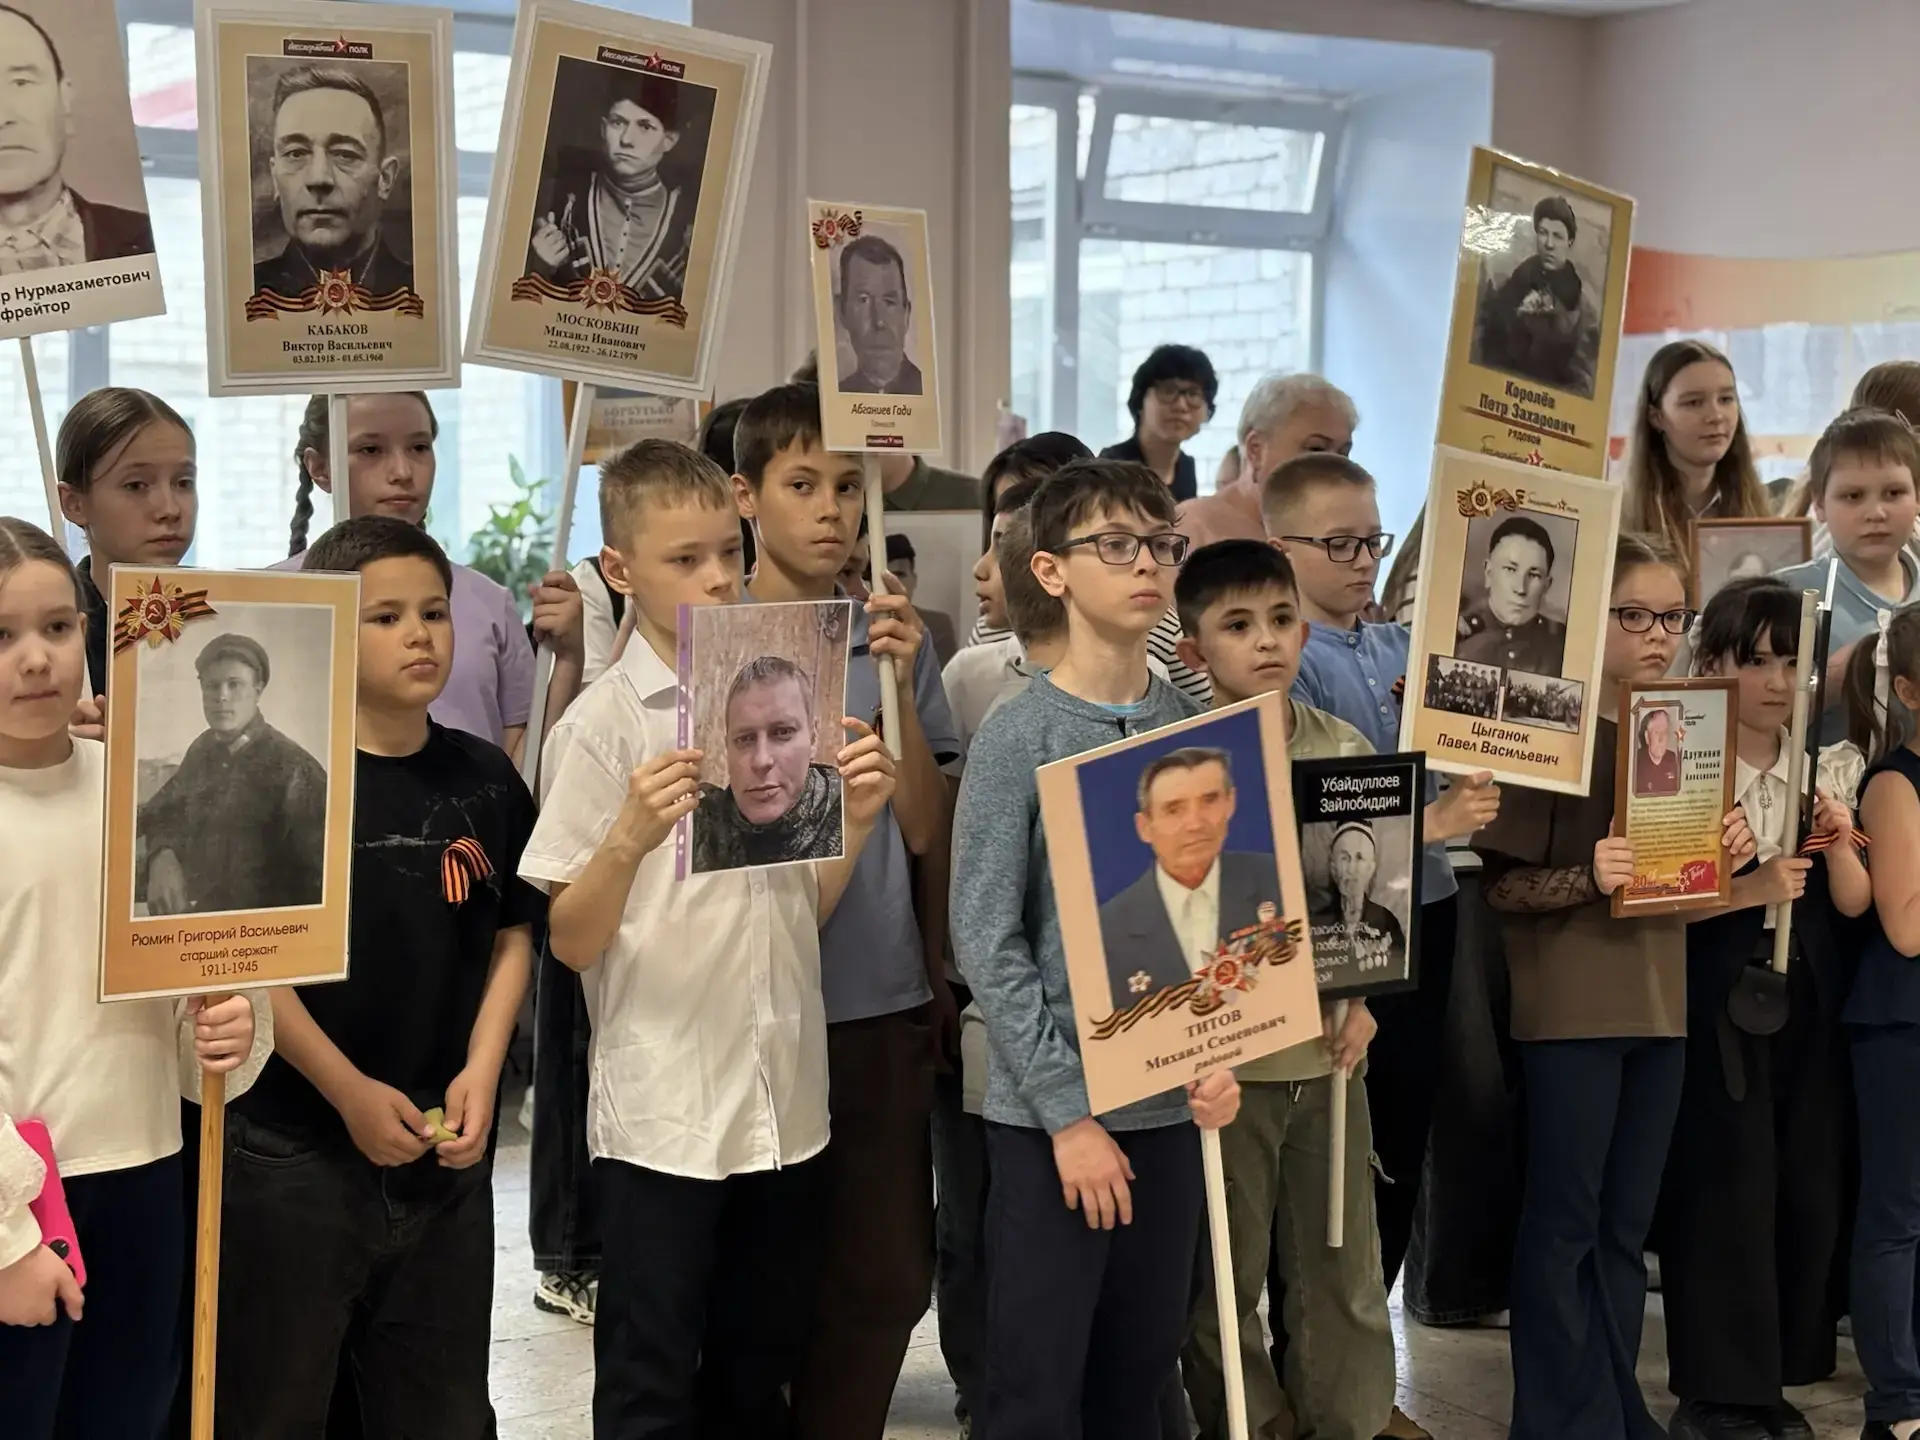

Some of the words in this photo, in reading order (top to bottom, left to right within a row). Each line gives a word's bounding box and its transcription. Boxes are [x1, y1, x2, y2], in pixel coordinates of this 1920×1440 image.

[0, 292, 11, 304] р
[15, 270, 151, 301] Нурмахаметович
[0, 300, 71, 323] фрейтор
[307, 324, 368, 336] КАБАКОВ
[556, 312, 640, 336] МОСКОВКИН
[282, 341, 324, 353] Виктор
[328, 340, 392, 351] Васильевич
[544, 325, 589, 342] Михаил
[592, 333, 646, 351] Иванович
[292, 354, 335, 364] 03.02.1918
[596, 348, 639, 361] 26.12.1979
[1505, 380, 1556, 409] Королёв
[851, 403, 891, 415] Абганиев
[892, 404, 912, 416] Гади
[1479, 393, 1508, 416] Петр
[1511, 403, 1576, 436] Захарович
[1471, 721, 1530, 744] Цыганок
[1437, 733, 1477, 752] Павел
[1480, 741, 1560, 766] Васильевич
[1321, 775, 1400, 793] Убайдуллоев
[1320, 795, 1400, 813] Зайлобиддин
[132, 933, 174, 947] Рюмин
[178, 927, 236, 946] Григорий
[240, 923, 309, 938] Васильевич
[1309, 922, 1345, 936] пасибо
[180, 946, 229, 963] старший
[232, 944, 278, 958] сержант
[200, 961, 259, 977] 1911-1945
[1185, 1009, 1242, 1039] ТИТОВ
[1144, 1043, 1204, 1072] Михаил
[1208, 1015, 1287, 1049] Семенович
[1194, 1047, 1242, 1074] рядовой
